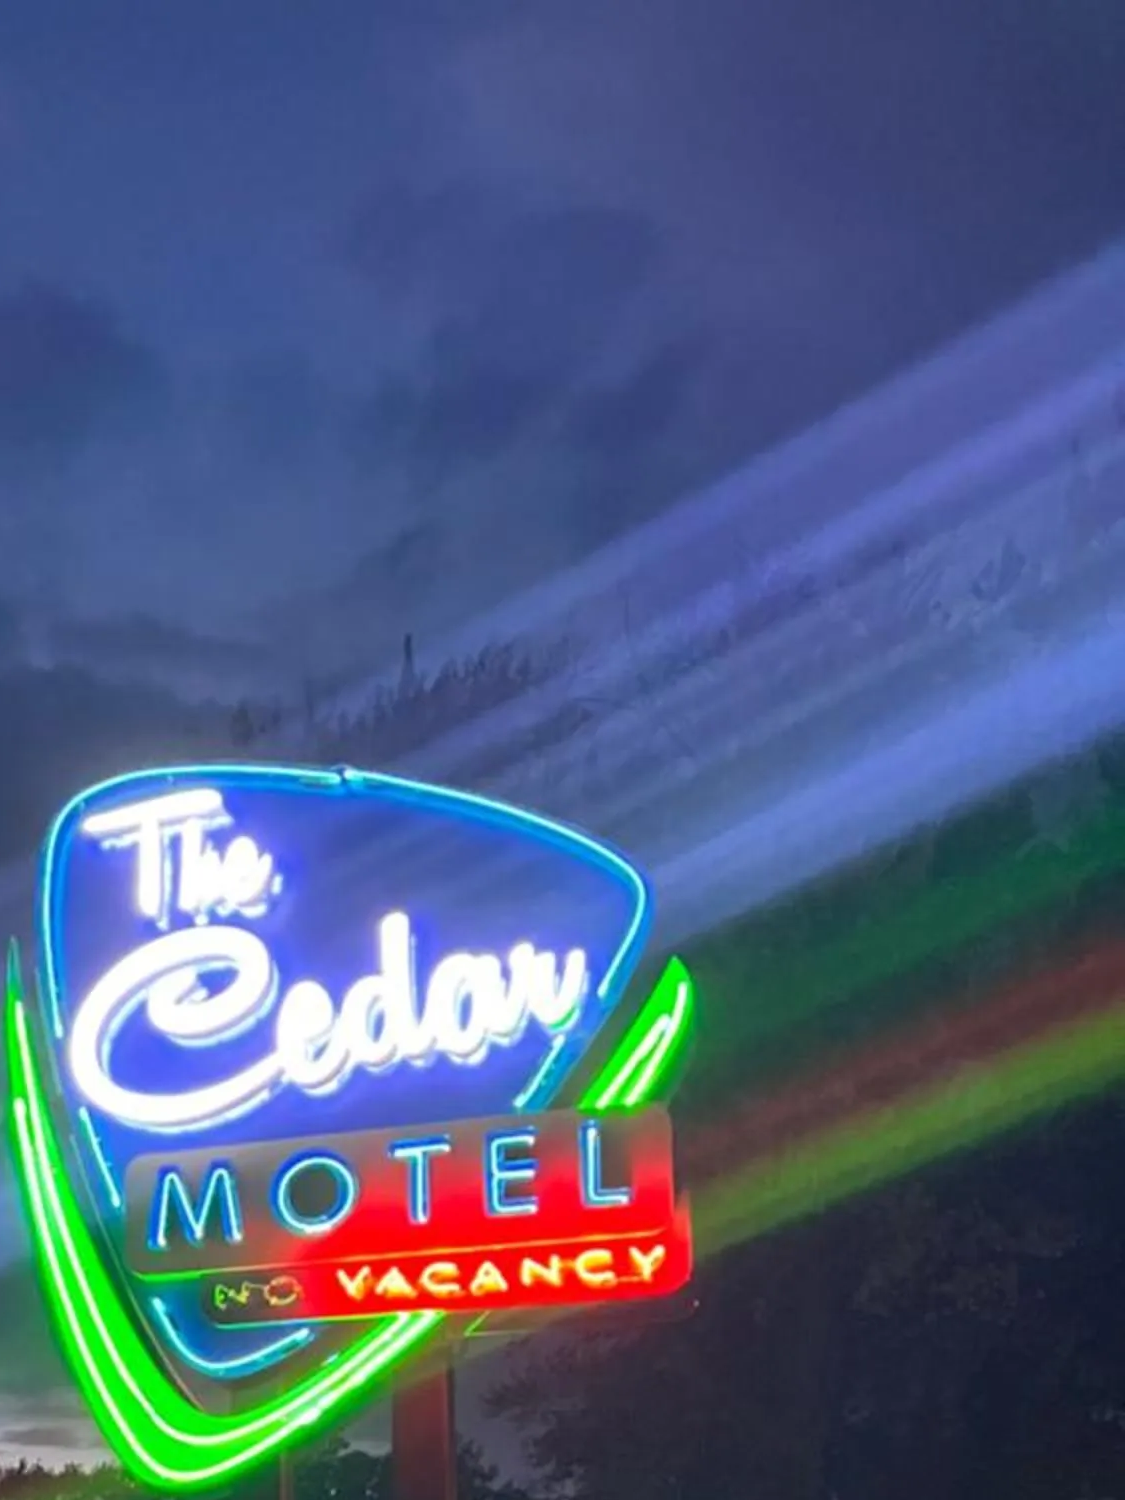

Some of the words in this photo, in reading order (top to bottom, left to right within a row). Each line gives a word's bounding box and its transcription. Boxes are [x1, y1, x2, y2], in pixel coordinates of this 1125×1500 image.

[81, 787, 281, 928] The
[70, 910, 587, 1130] Cedar
[148, 1120, 630, 1249] MOTEL
[336, 1243, 667, 1302] VACANCY
